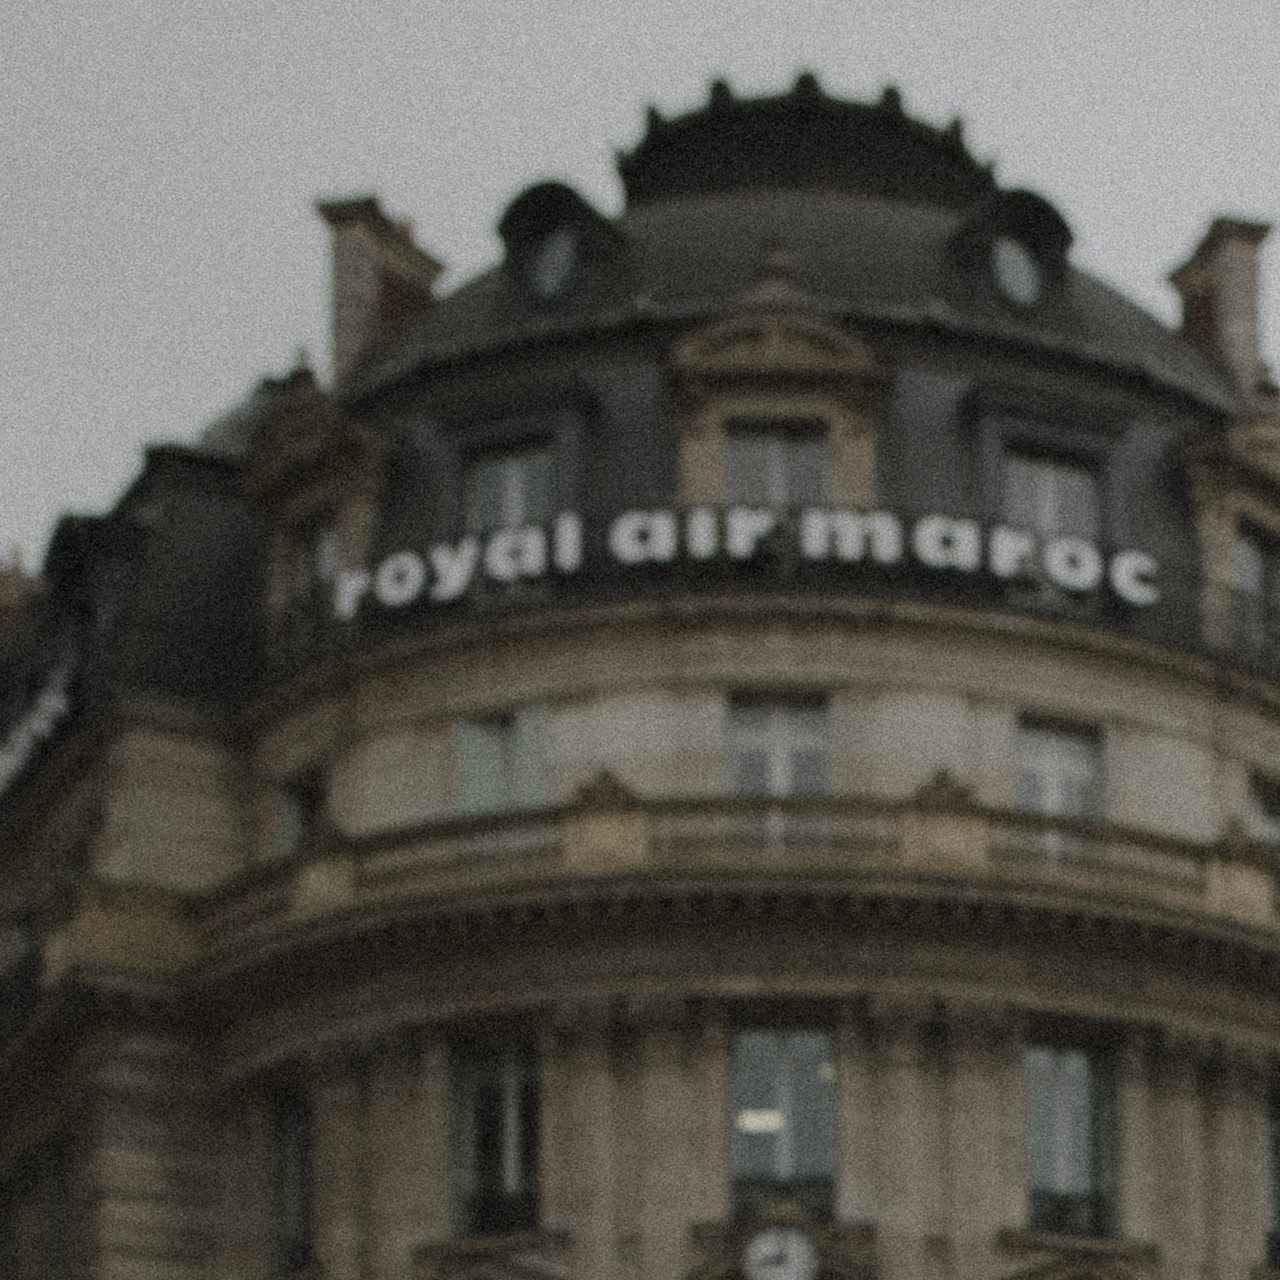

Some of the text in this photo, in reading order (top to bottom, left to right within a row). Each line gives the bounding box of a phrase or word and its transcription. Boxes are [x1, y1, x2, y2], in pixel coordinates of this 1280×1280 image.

[333, 507, 1162, 620] royal air maroc
